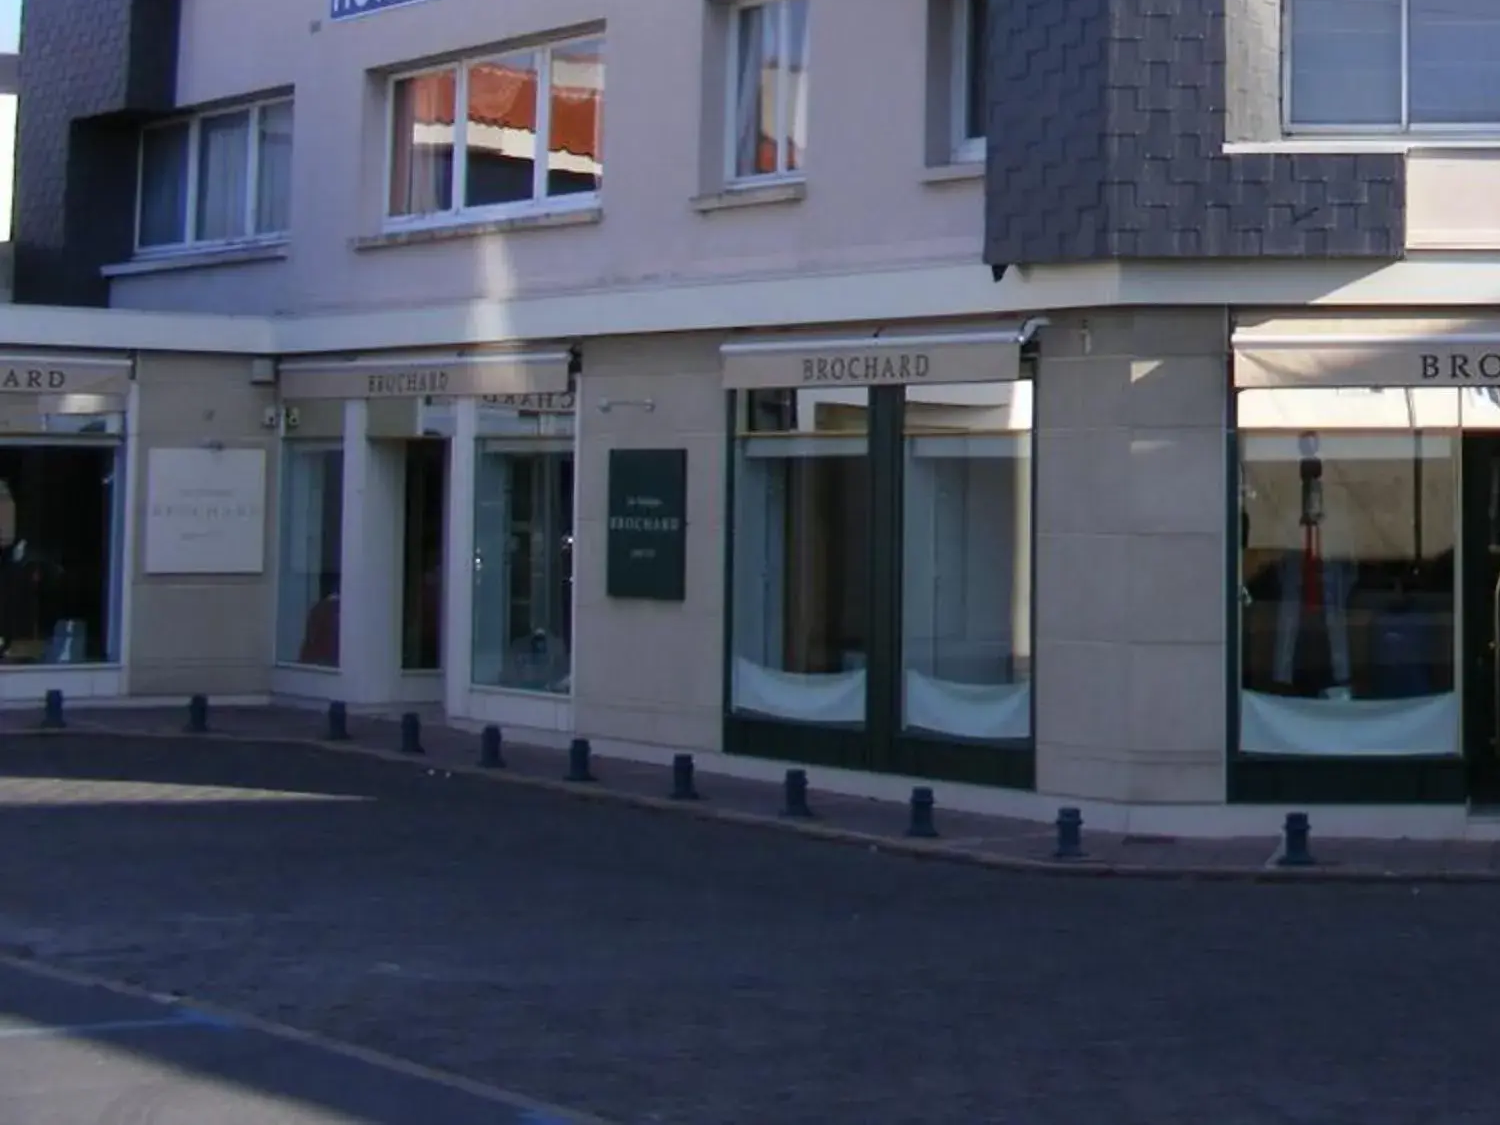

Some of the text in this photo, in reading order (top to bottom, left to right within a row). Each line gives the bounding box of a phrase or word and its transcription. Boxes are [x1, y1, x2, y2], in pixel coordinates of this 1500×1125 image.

[802, 355, 931, 381] BROCHARD
[3, 369, 66, 388] ARD
[609, 516, 680, 532] BROCHARD
